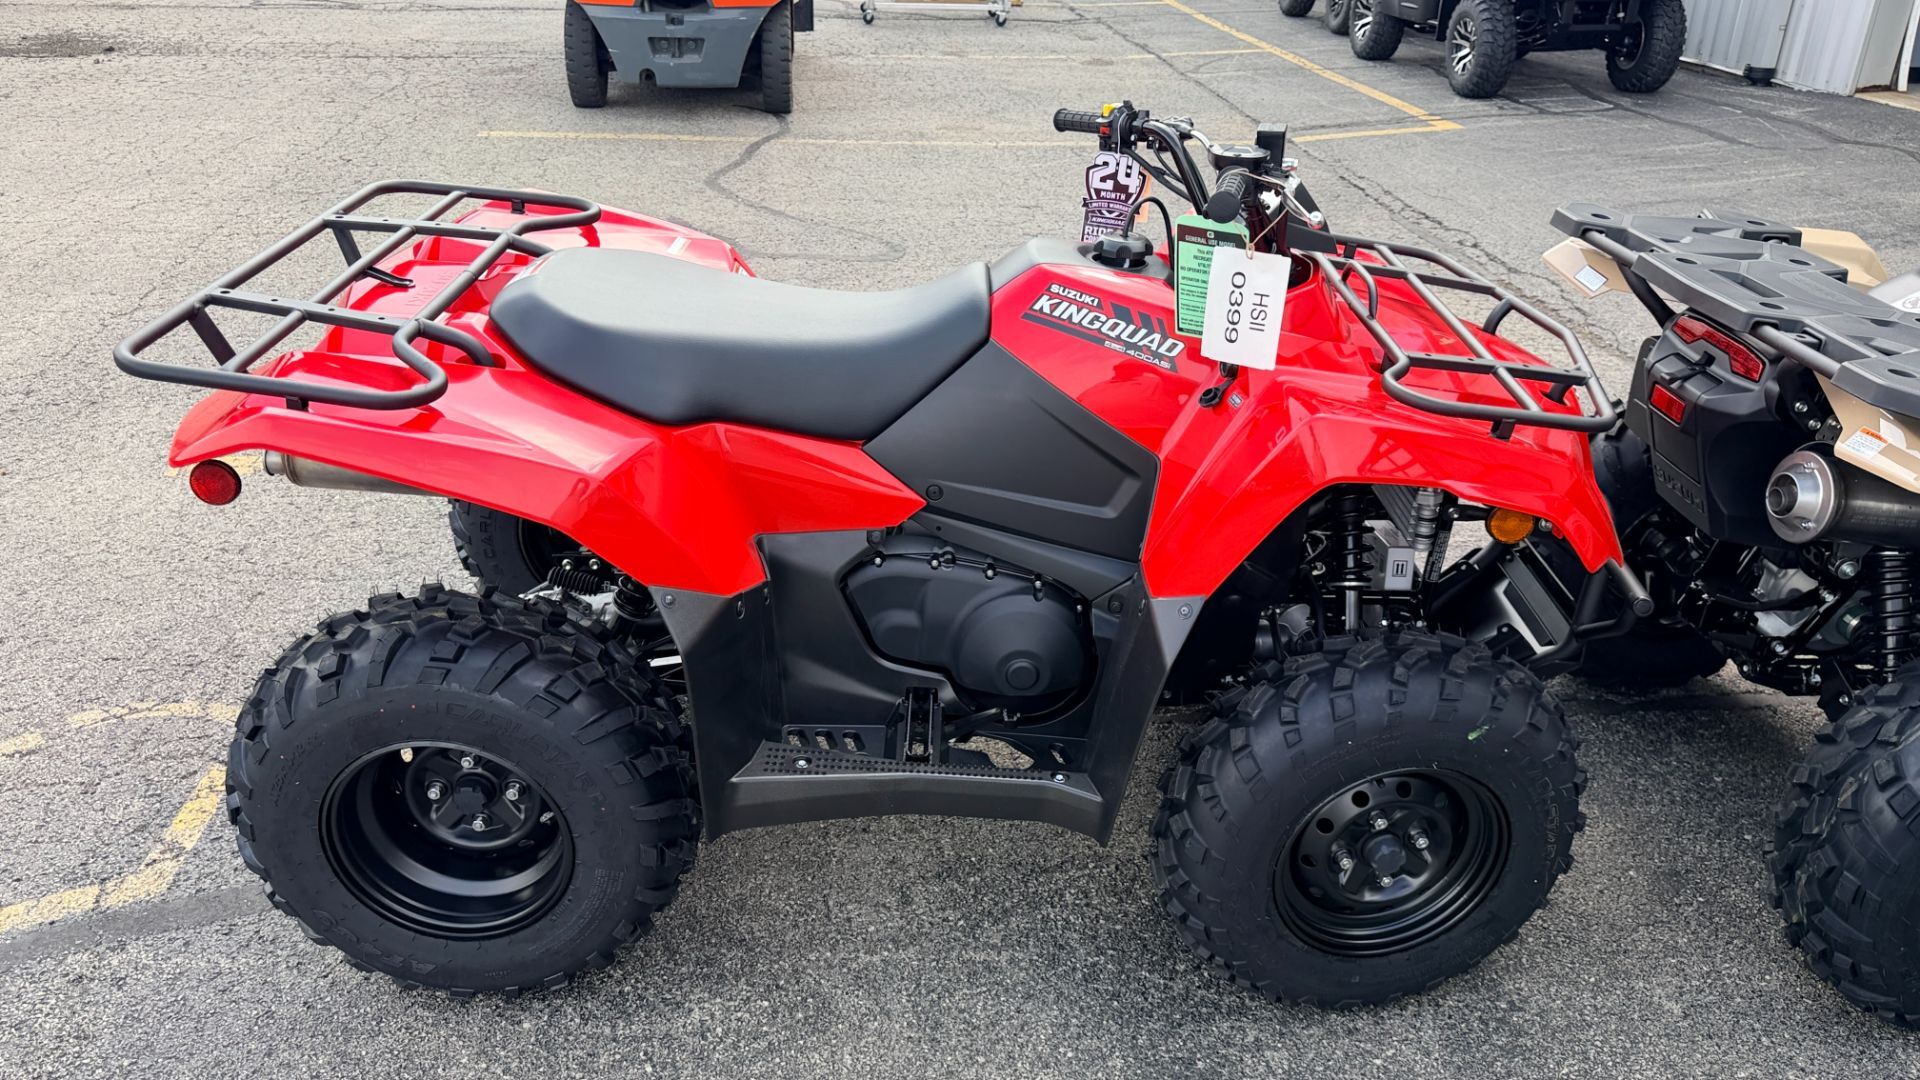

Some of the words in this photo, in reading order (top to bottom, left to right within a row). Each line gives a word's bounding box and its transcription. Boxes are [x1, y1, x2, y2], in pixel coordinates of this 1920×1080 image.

[1090, 151, 1141, 194] 24
[1088, 201, 1109, 210] LIMITED
[1100, 190, 1126, 201] MONTH
[1185, 234, 1207, 245] GENERAL
[1207, 239, 1218, 247] USE
[1050, 283, 1099, 307] SUZUKI
[1224, 271, 1247, 344] 0399
[1033, 294, 1185, 357] KINGQUAD
